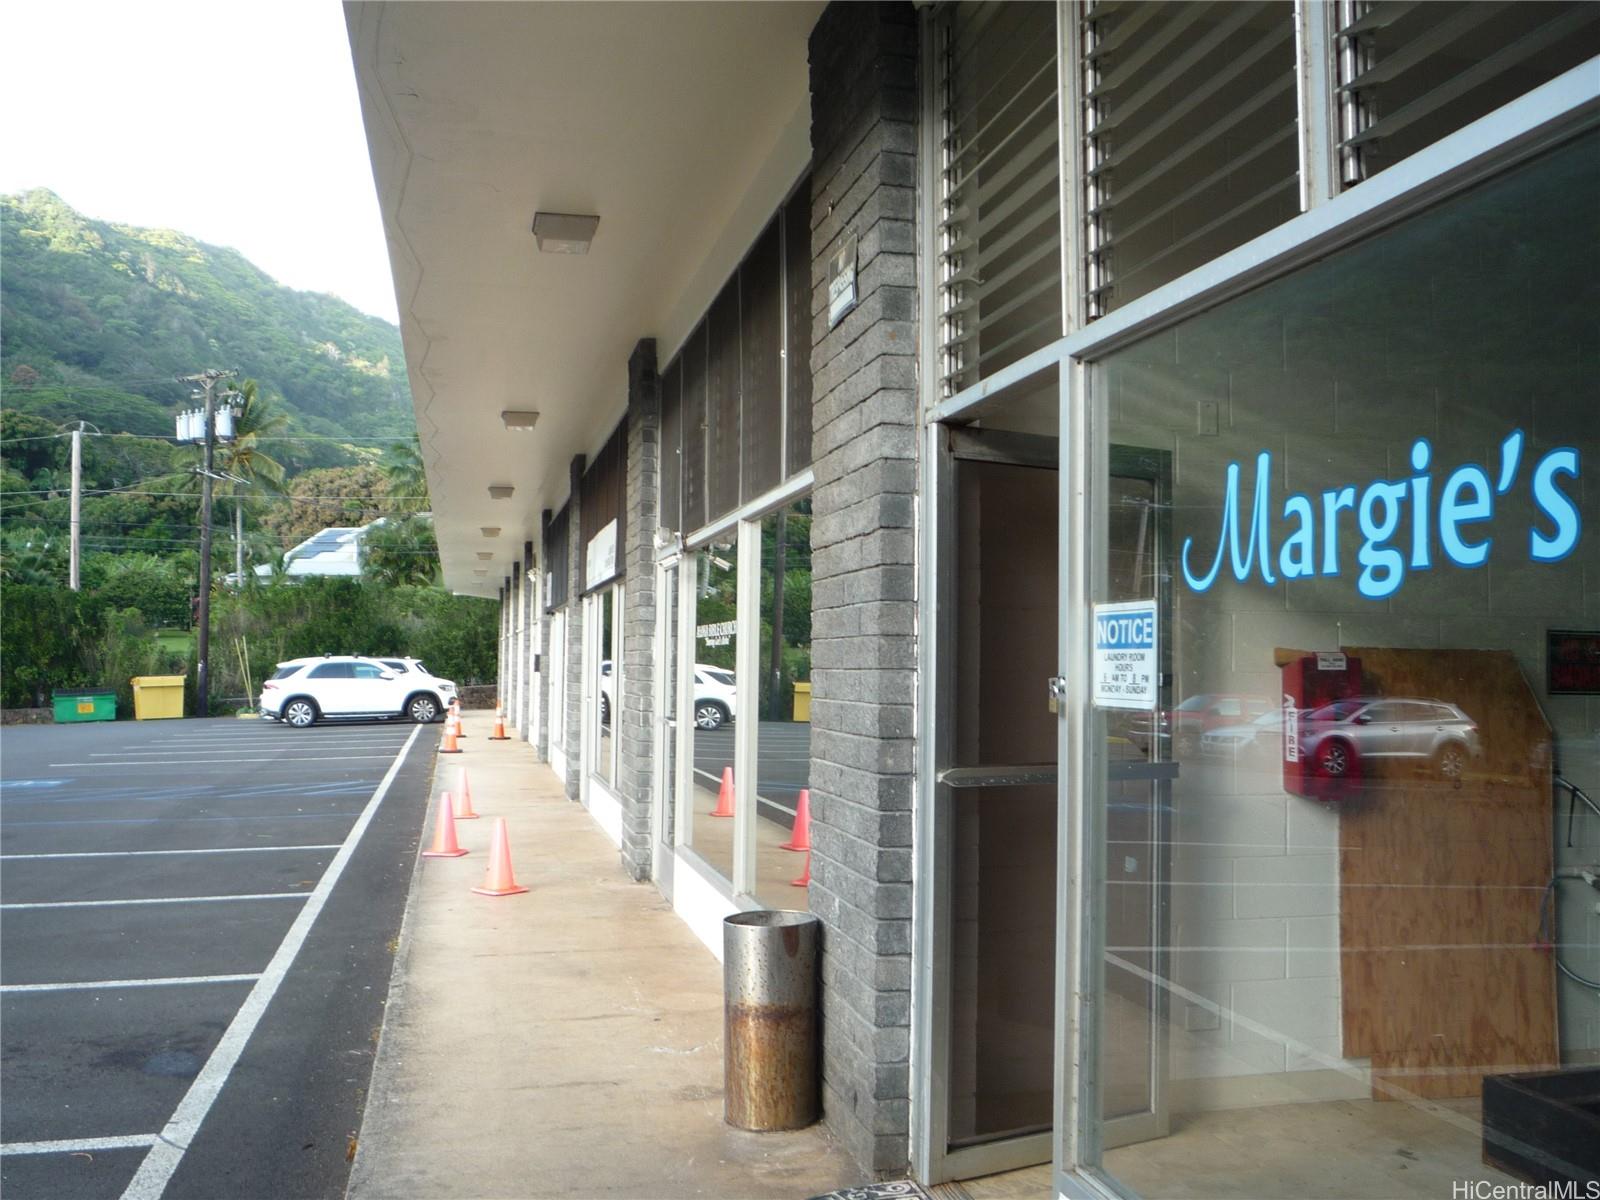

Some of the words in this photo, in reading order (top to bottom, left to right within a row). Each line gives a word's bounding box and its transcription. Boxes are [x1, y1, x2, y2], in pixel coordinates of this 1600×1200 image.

[1181, 428, 1581, 600] Margie's
[1097, 617, 1152, 645] NOTICE
[1104, 653, 1127, 661] LAUNDRY
[1129, 653, 1145, 661] ROOM
[1115, 663, 1133, 671] HOURS
[1112, 674, 1119, 682] AM
[1121, 673, 1127, 682] TO
[1141, 674, 1149, 683] PM
[1100, 685, 1121, 693] MONDAY
[1126, 685, 1147, 694] SUNDAY
[1287, 711, 1297, 758] FIRE
